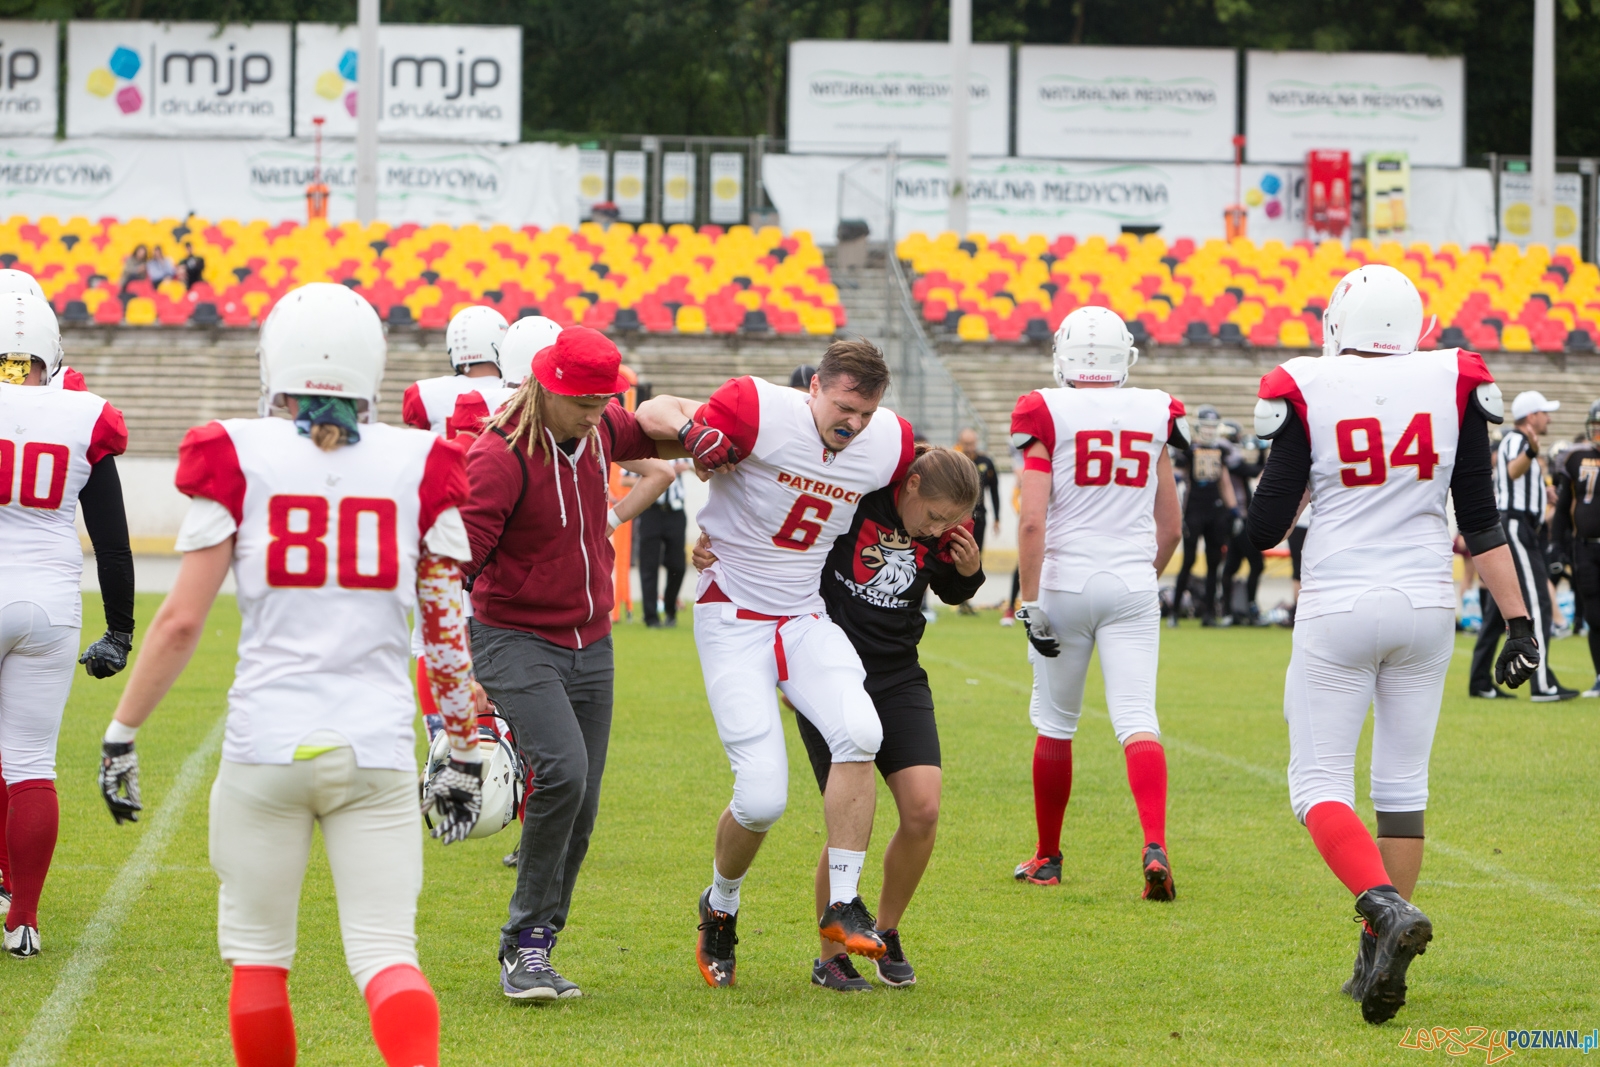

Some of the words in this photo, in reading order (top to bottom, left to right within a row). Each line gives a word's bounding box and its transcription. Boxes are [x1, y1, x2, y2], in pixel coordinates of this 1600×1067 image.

[162, 44, 273, 96] mjp
[391, 49, 502, 100] mjp
[905, 83, 990, 100] MEDYNA
[161, 96, 274, 118] drukarnia
[389, 101, 502, 120] drukarnia
[387, 166, 498, 192] MEDYCYNA
[1041, 180, 1168, 205] MEDYCYNA
[1373, 342, 1401, 351] Riddell
[1079, 373, 1112, 381] Riddell
[1074, 429, 1153, 489] 65
[1335, 412, 1440, 488] 94
[777, 471, 863, 506] PATRIOCI
[771, 493, 834, 552] 6
[266, 494, 399, 590] 80
